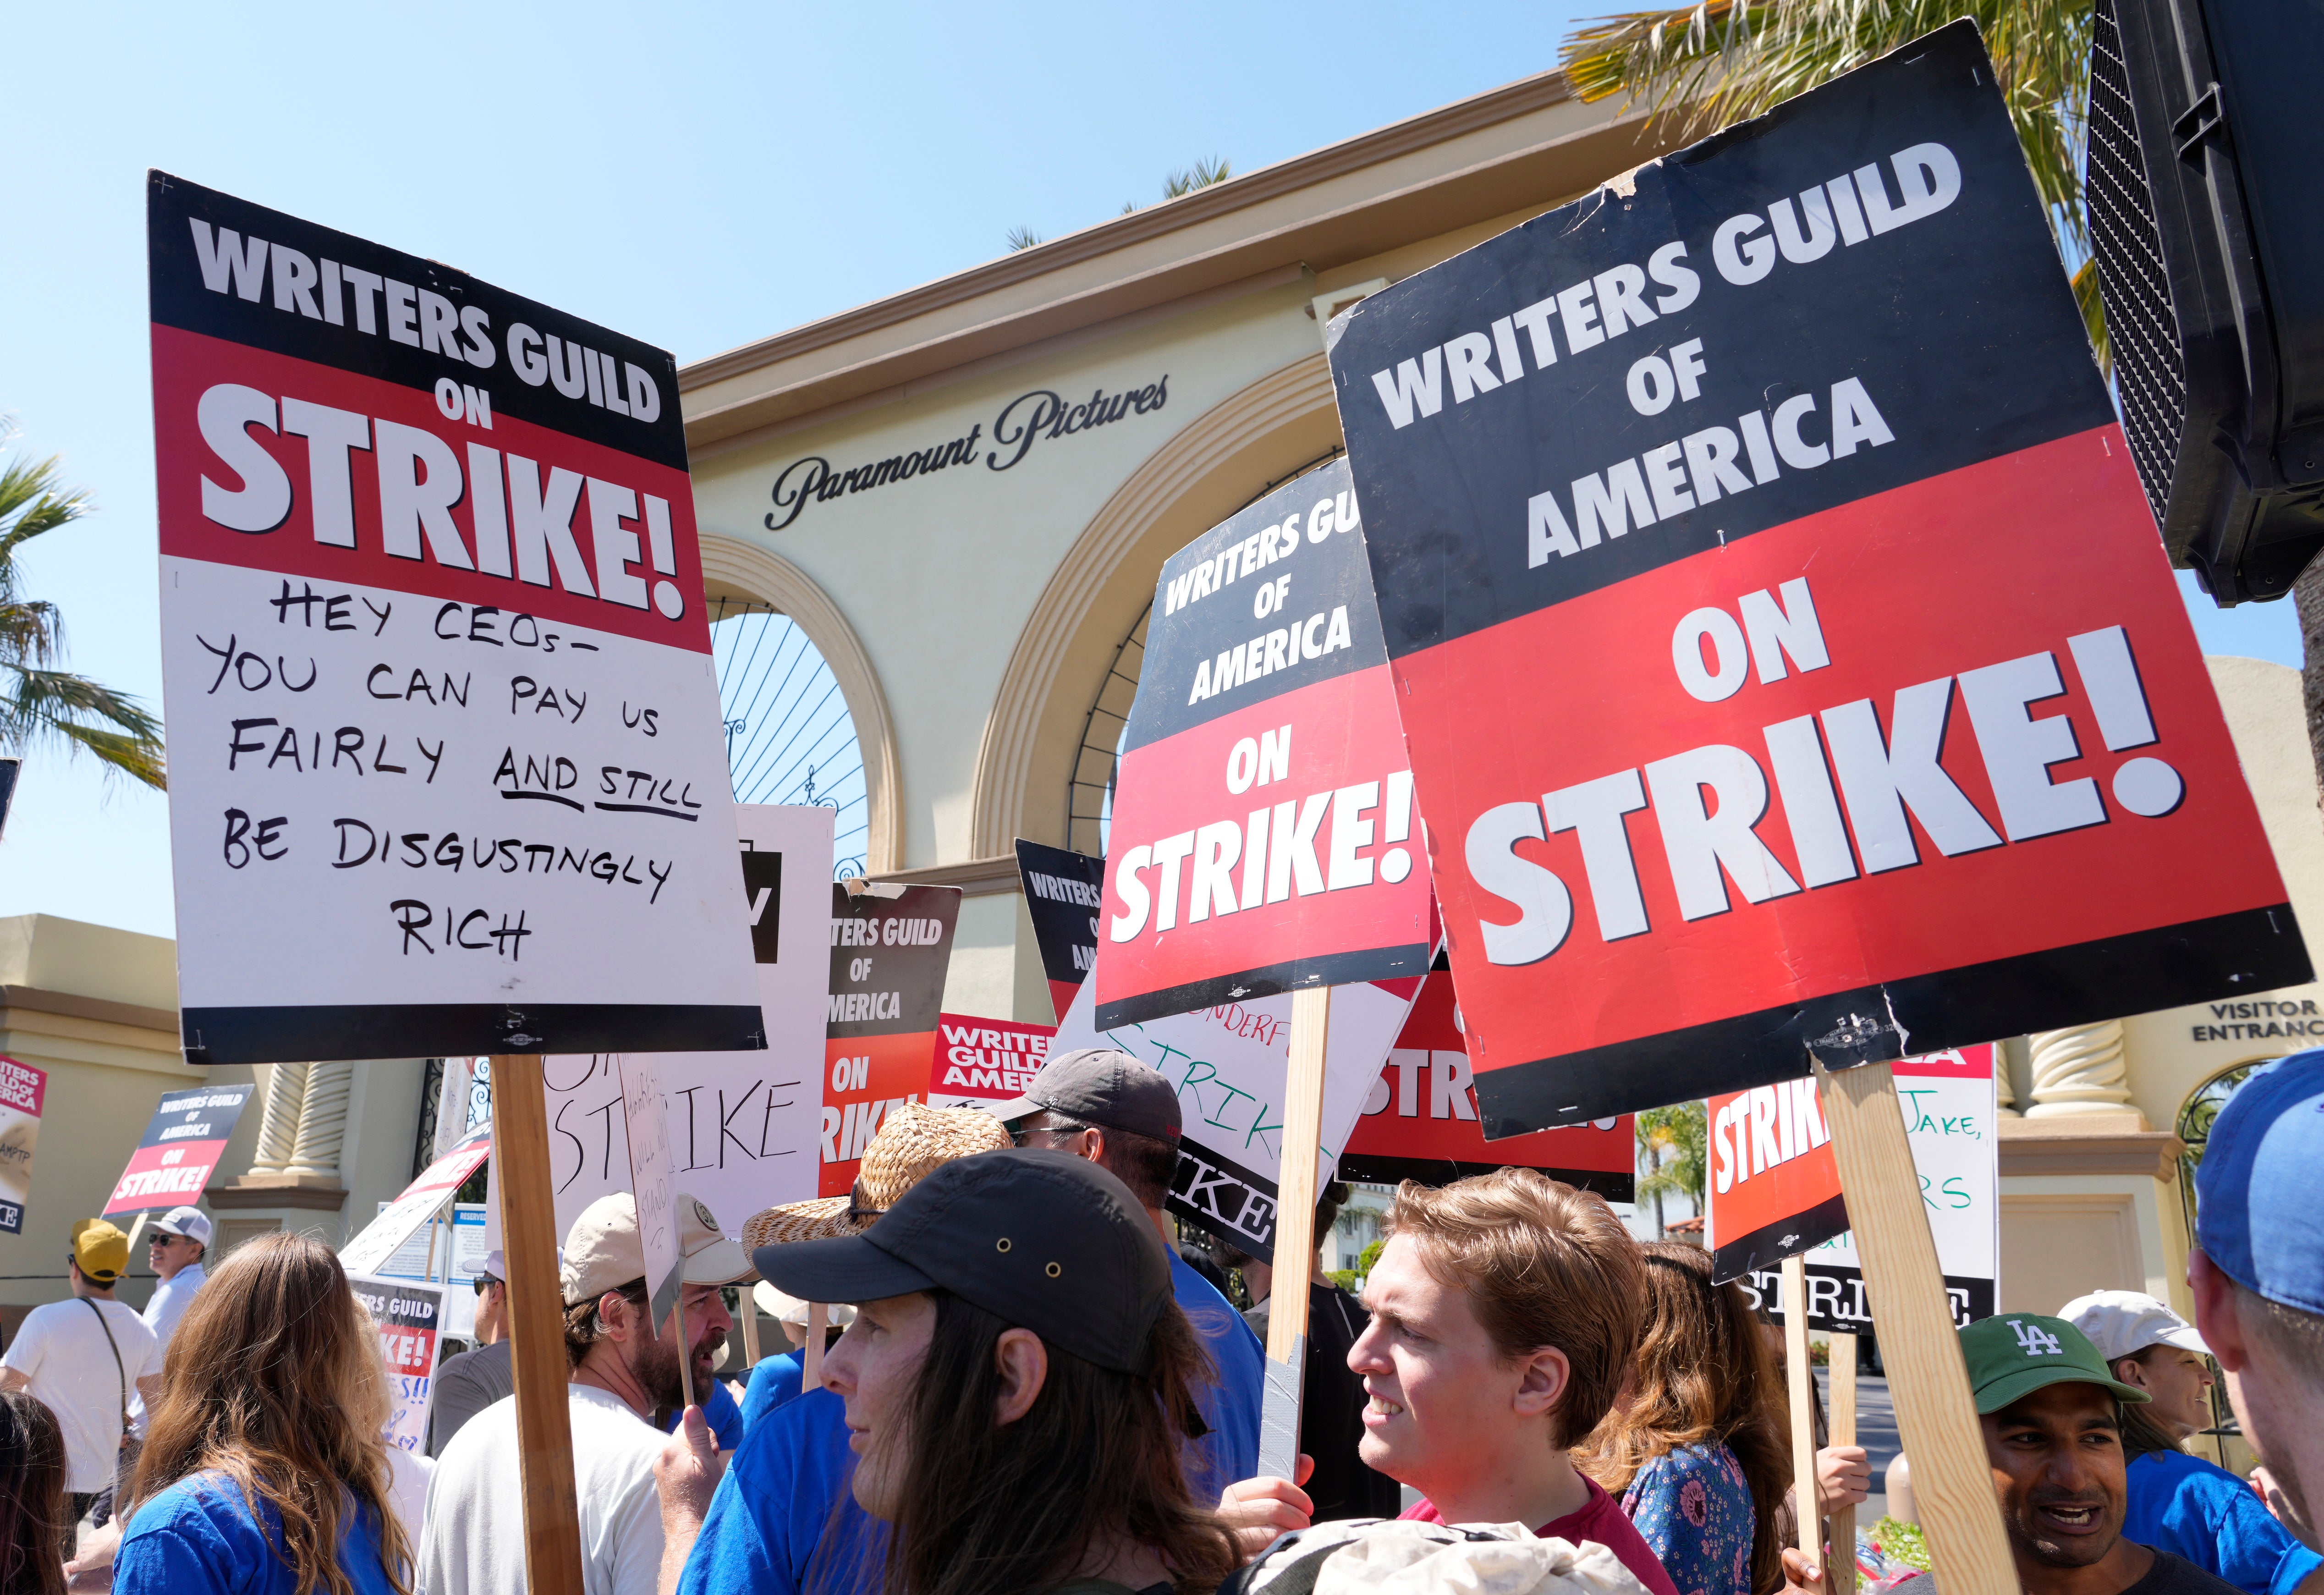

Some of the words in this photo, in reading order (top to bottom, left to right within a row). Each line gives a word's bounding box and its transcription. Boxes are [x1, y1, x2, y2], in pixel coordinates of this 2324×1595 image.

[1371, 241, 1701, 430] WRITERS
[1712, 143, 1961, 286] GUILD
[189, 217, 496, 368] WRITERS
[507, 322, 660, 423] GUILD
[1626, 337, 1707, 415] OF
[434, 377, 493, 430] ON
[764, 424, 981, 531] Paramount
[987, 374, 1169, 471] Pictures
[1528, 376, 1895, 569] AMERICA
[197, 383, 685, 620] STRIKE!
[1165, 513, 1300, 617] WRITERS
[269, 579, 392, 637] HEY
[1254, 572, 1291, 619] OF
[1188, 605, 1352, 706] AMERICA
[1672, 576, 1831, 703] ON
[196, 634, 317, 694] YOU
[367, 663, 471, 708] CAN
[511, 676, 587, 724] PAY
[229, 718, 444, 784] FAIRLY
[493, 746, 578, 797] AND
[599, 766, 703, 809] STILL
[1226, 724, 1292, 795] ON
[1464, 624, 2185, 966] STRIKE!
[223, 808, 289, 869] BE
[332, 818, 673, 905] DISGUSTINGLY
[1110, 770, 1413, 944] STRIKE!
[1028, 871, 1101, 908] WRITERS
[390, 899, 533, 961] RICH
[830, 918, 879, 947] TERS
[883, 918, 942, 946] GUILD
[1089, 917, 1099, 938] O
[849, 958, 872, 982] OF
[826, 991, 900, 1023] MERICA
[1188, 1002, 1291, 1058] NDERF
[2192, 1020, 2324, 1042] ENTRANC
[2210, 1000, 2319, 1020] VISITOR
[941, 1024, 1055, 1054] WRITE
[948, 1046, 1045, 1073] GUILD
[0, 1060, 39, 1086] ITERS
[832, 1056, 869, 1093] ON
[942, 1066, 1035, 1092] AMER
[160, 1096, 207, 1114] WRITERS
[207, 1094, 243, 1107] GUILD
[185, 1111, 200, 1122] OF
[1898, 1090, 1981, 1140] JAKE,
[159, 1123, 211, 1140] AMERICA
[551, 1078, 802, 1195] STIKE
[1166, 1124, 1178, 1138] RED
[1715, 1077, 1831, 1194] STRIK
[115, 1165, 209, 1199] STRIKE!
[161, 1149, 186, 1165] ON
[390, 1298, 433, 1319] GUILD
[2006, 1320, 2062, 1356] LA
